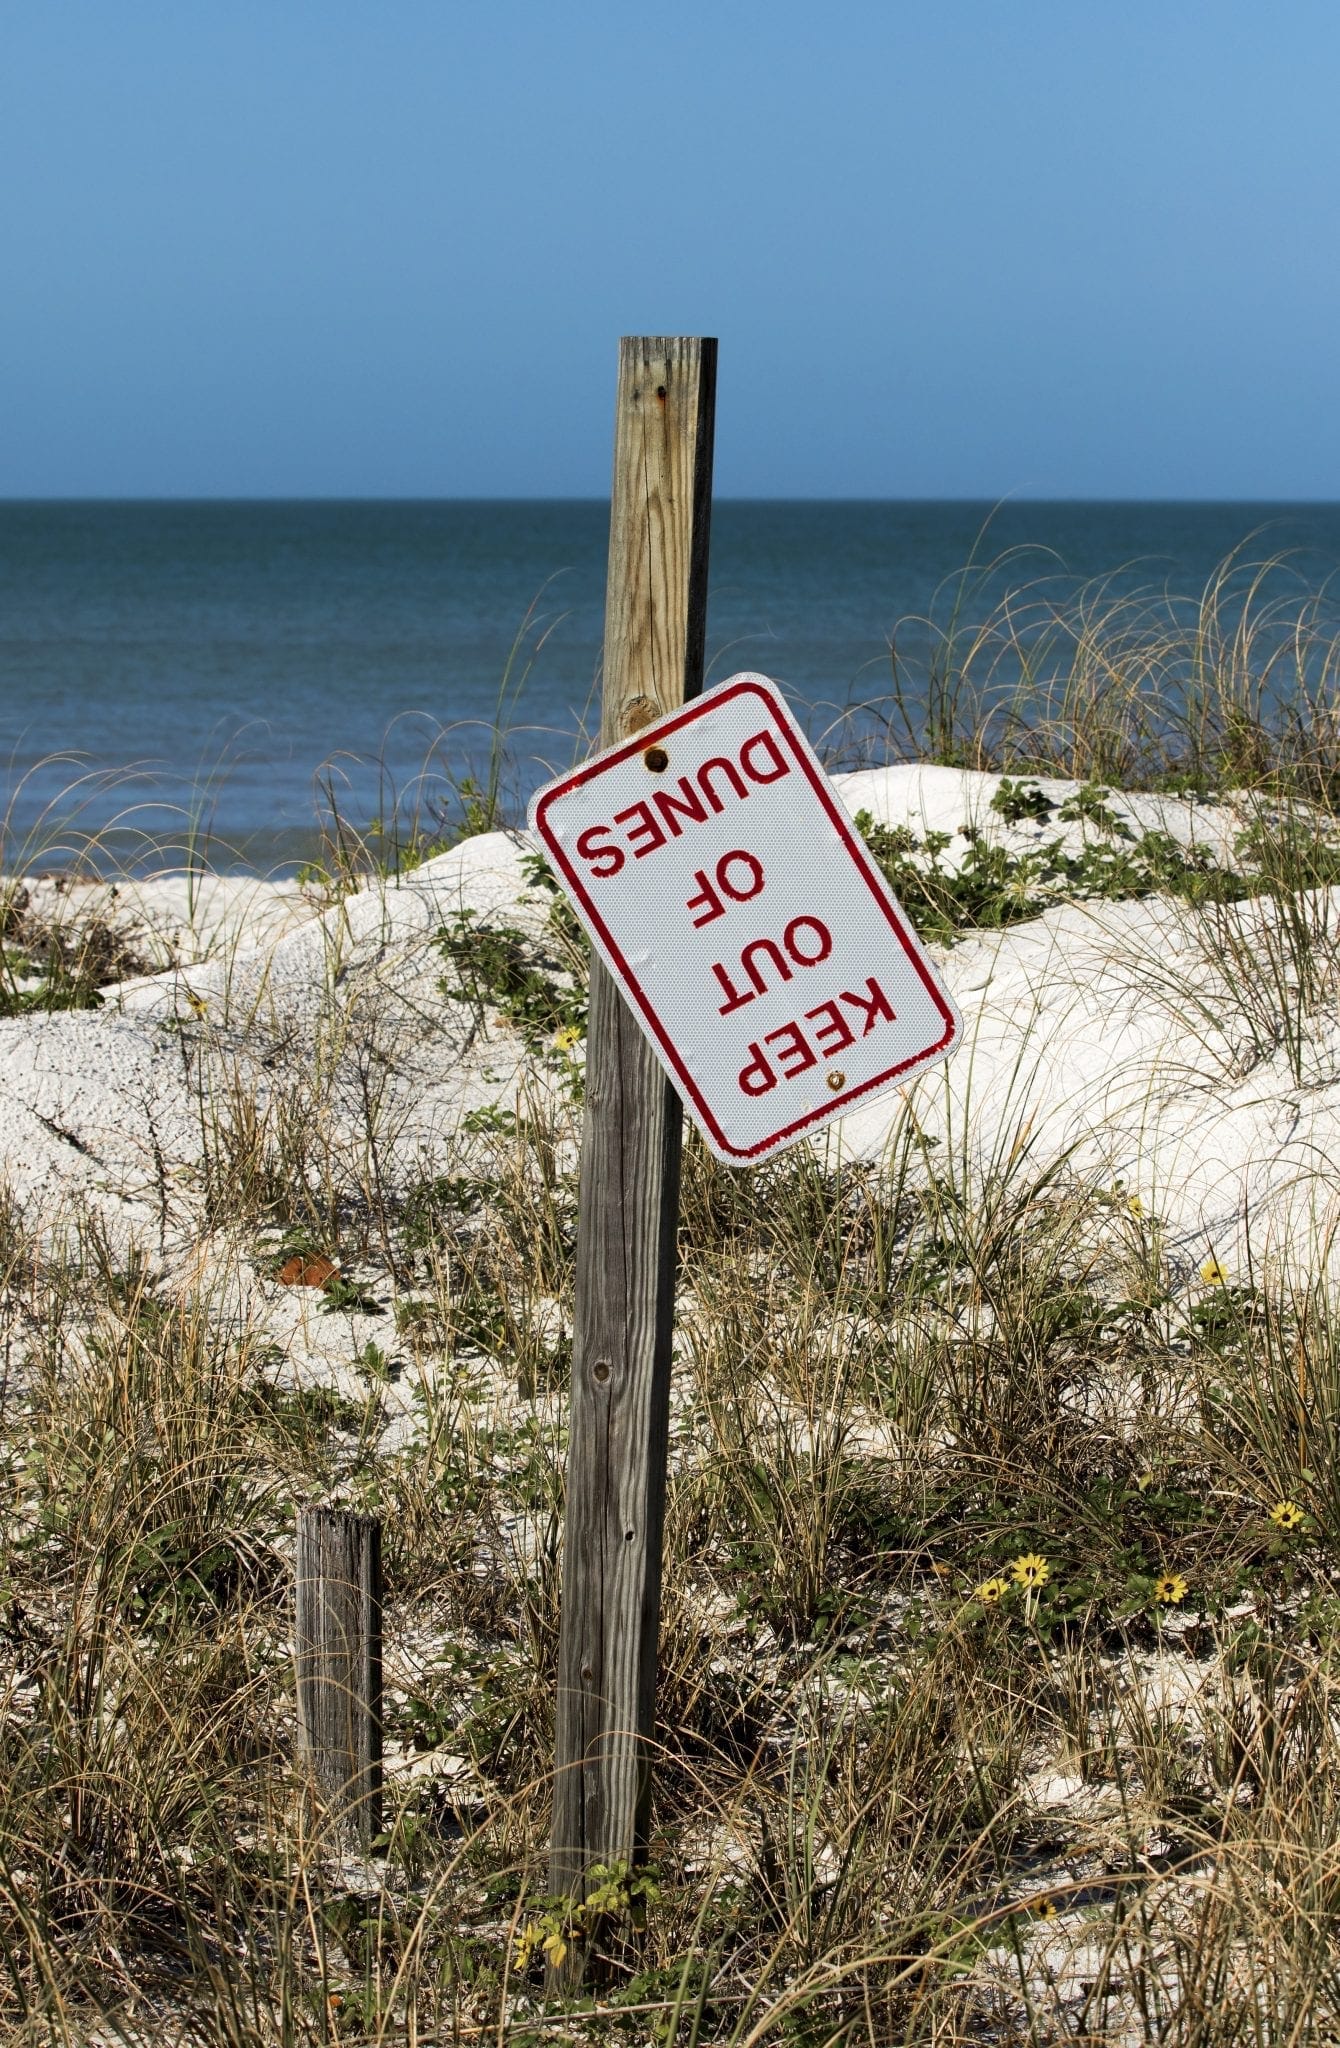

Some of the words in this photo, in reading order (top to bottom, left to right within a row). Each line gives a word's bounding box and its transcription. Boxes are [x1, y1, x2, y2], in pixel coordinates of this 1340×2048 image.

[577, 730, 789, 878] DUNES
[687, 850, 764, 928] OF
[712, 916, 832, 1015] OUT
[738, 977, 896, 1097] KEEP
